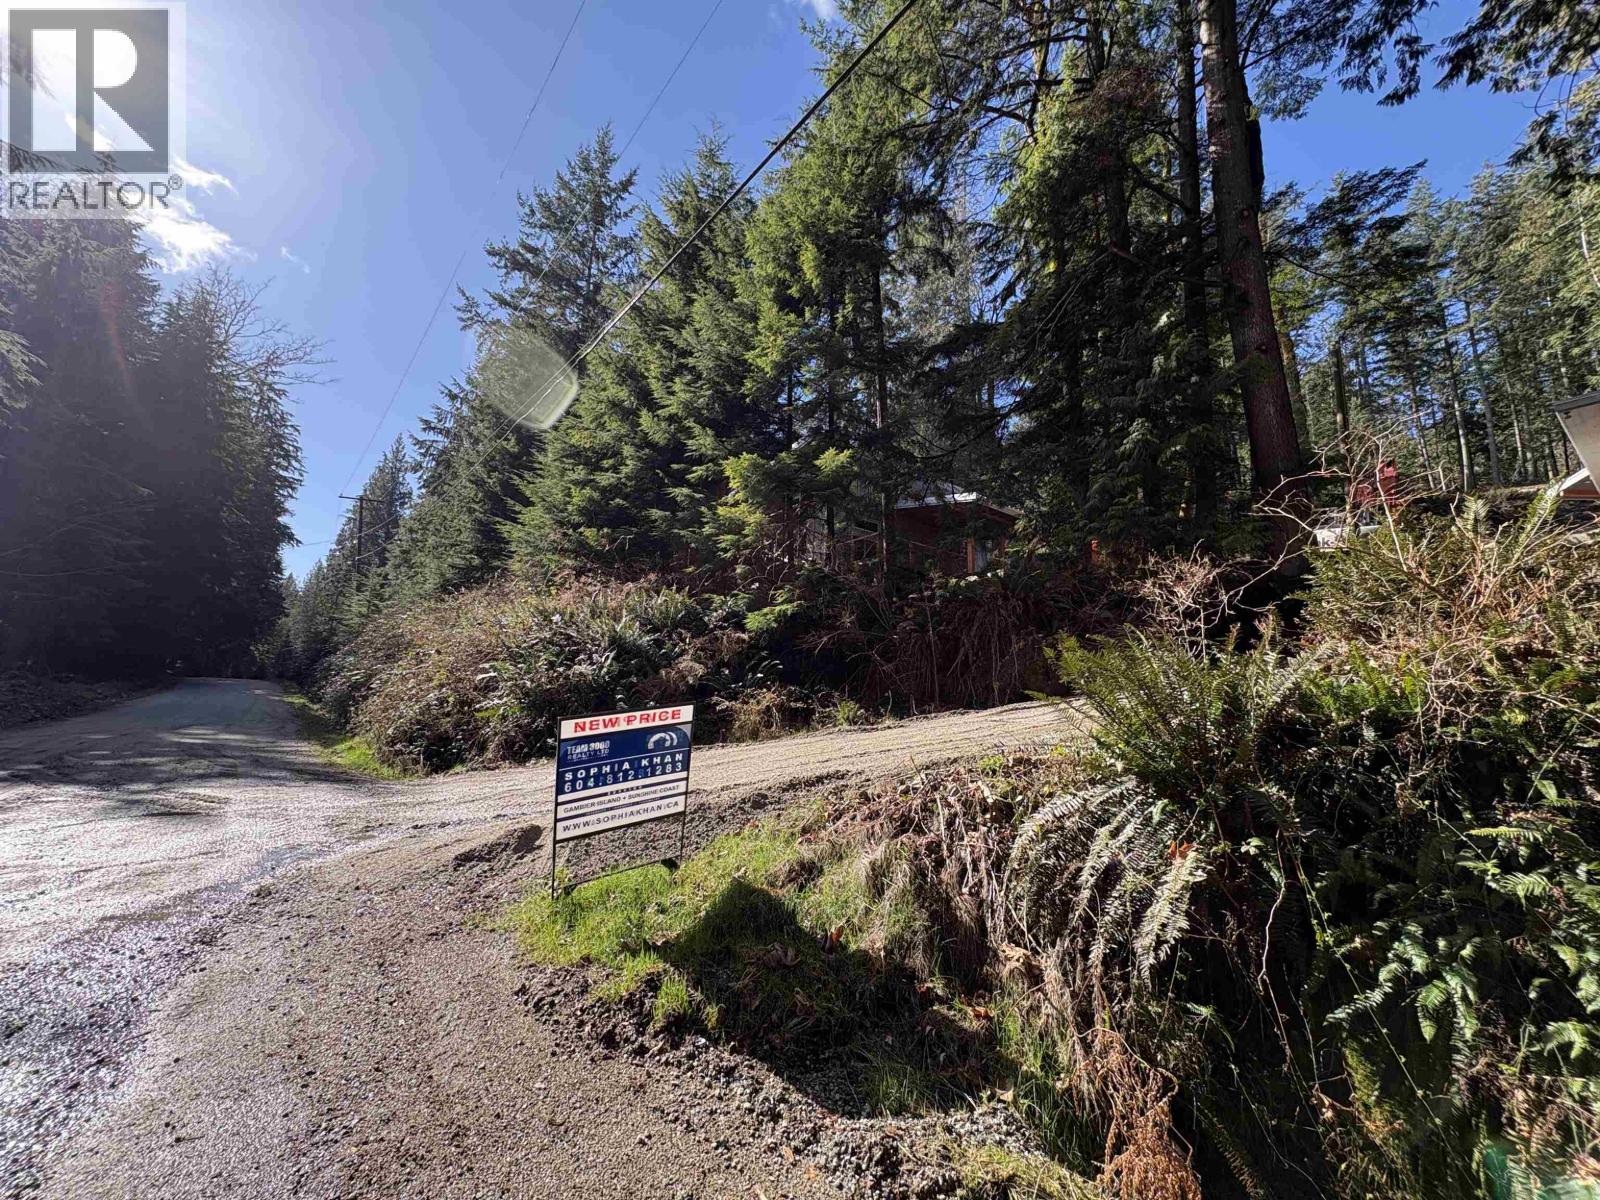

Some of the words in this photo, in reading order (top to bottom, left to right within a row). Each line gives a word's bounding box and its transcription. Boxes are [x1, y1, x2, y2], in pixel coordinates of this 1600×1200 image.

[573, 717, 619, 733] NEW
[625, 709, 682, 726] PRICE
[567, 744, 588, 755] TEAM
[565, 762, 631, 781] SOPHIA
[641, 753, 684, 767] KHAN
[563, 802, 596, 814] GAMBIER
[597, 797, 622, 809] ISLAND
[627, 789, 659, 800] SUNSHINE
[659, 785, 681, 795] COAST
